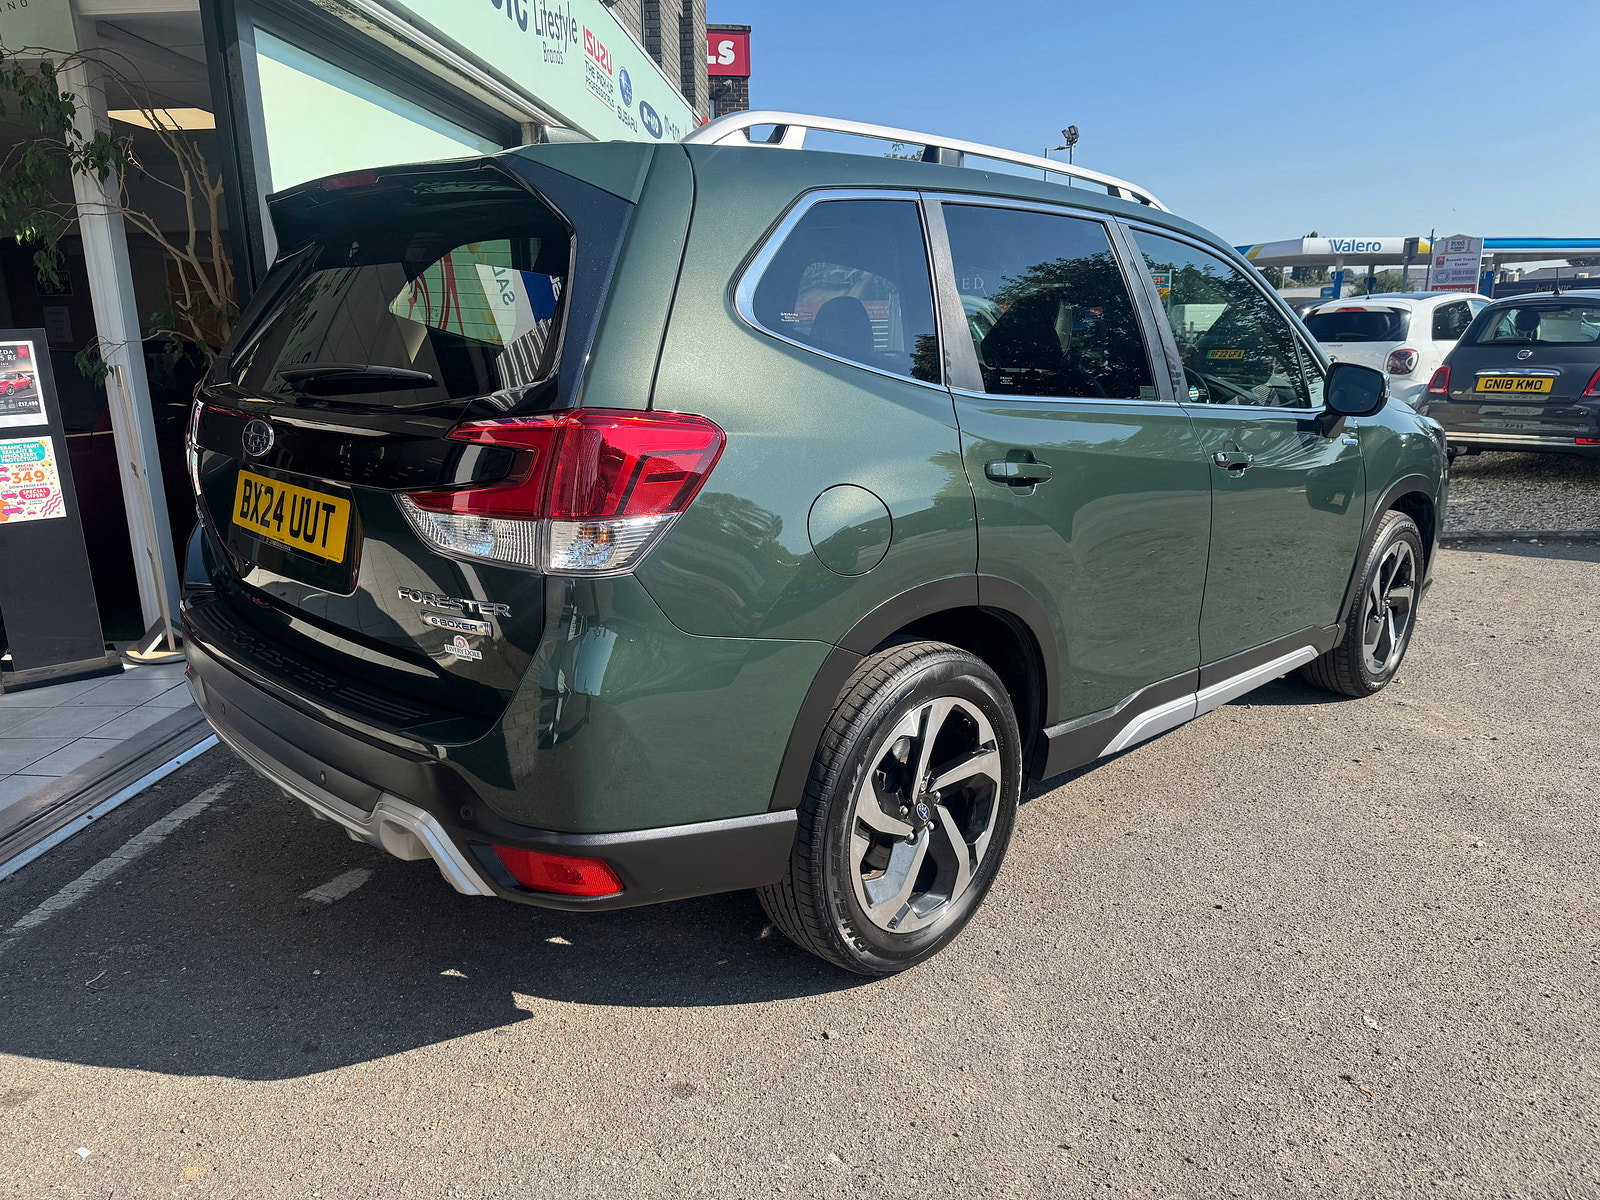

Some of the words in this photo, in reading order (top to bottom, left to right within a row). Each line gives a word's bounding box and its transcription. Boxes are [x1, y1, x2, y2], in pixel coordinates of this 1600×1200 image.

[533, 0, 578, 53] Lifestyle
[542, 41, 563, 65] Brands
[583, 24, 613, 76] ISUZU
[584, 60, 596, 79] THE
[617, 105, 638, 133] SUBARU
[1331, 238, 1382, 253] Valero
[1484, 379, 1513, 390] GN18
[1515, 379, 1543, 390] KMO
[11, 470, 45, 484] 349
[239, 478, 286, 533] BX24
[289, 493, 337, 548] UUT
[398, 586, 512, 618] FORESTER
